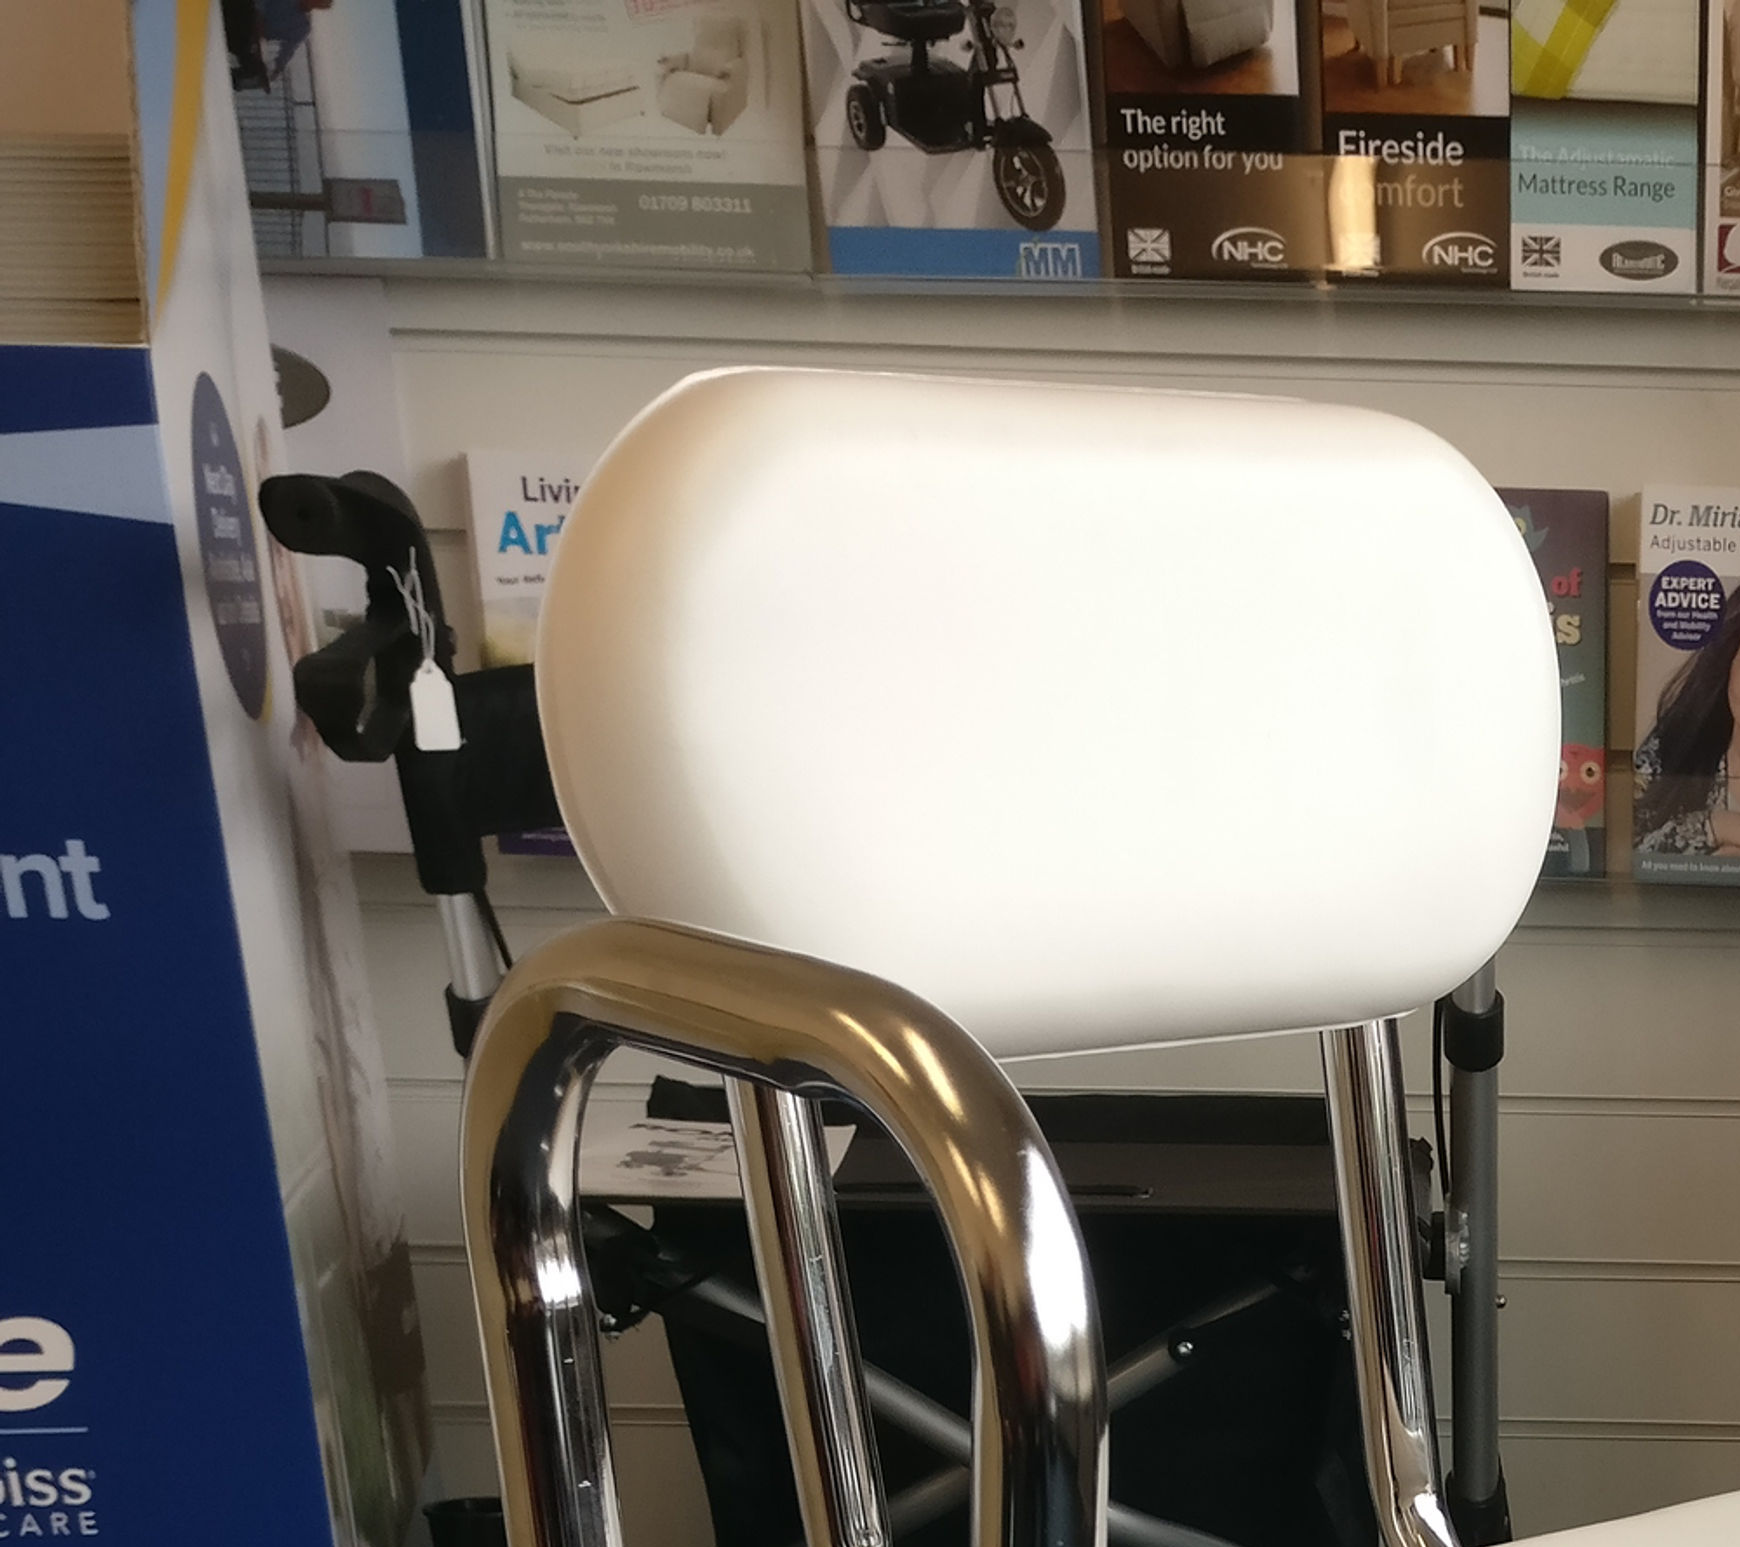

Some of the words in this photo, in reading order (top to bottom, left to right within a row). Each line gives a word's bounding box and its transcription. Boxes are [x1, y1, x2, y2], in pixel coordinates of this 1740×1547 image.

[1121, 108, 1166, 135] The
[1171, 109, 1226, 140] right
[1123, 143, 1200, 173] option
[1203, 145, 1236, 170] for
[1242, 153, 1284, 175] you
[1338, 130, 1465, 167] Fireside
[1376, 174, 1465, 209] mfort
[1518, 172, 1607, 197] Mattress
[1613, 175, 1677, 203] Range
[1221, 241, 1286, 264] NHC
[1432, 244, 1495, 267] NHC
[1650, 504, 1682, 526] Dr.
[498, 510, 565, 555] Ar
[1650, 535, 1736, 554] Adjustable
[1552, 568, 1582, 598] of
[1661, 576, 1715, 591] EXPERT
[1654, 591, 1720, 609] ADVICE
[0, 1457, 92, 1507] iss
